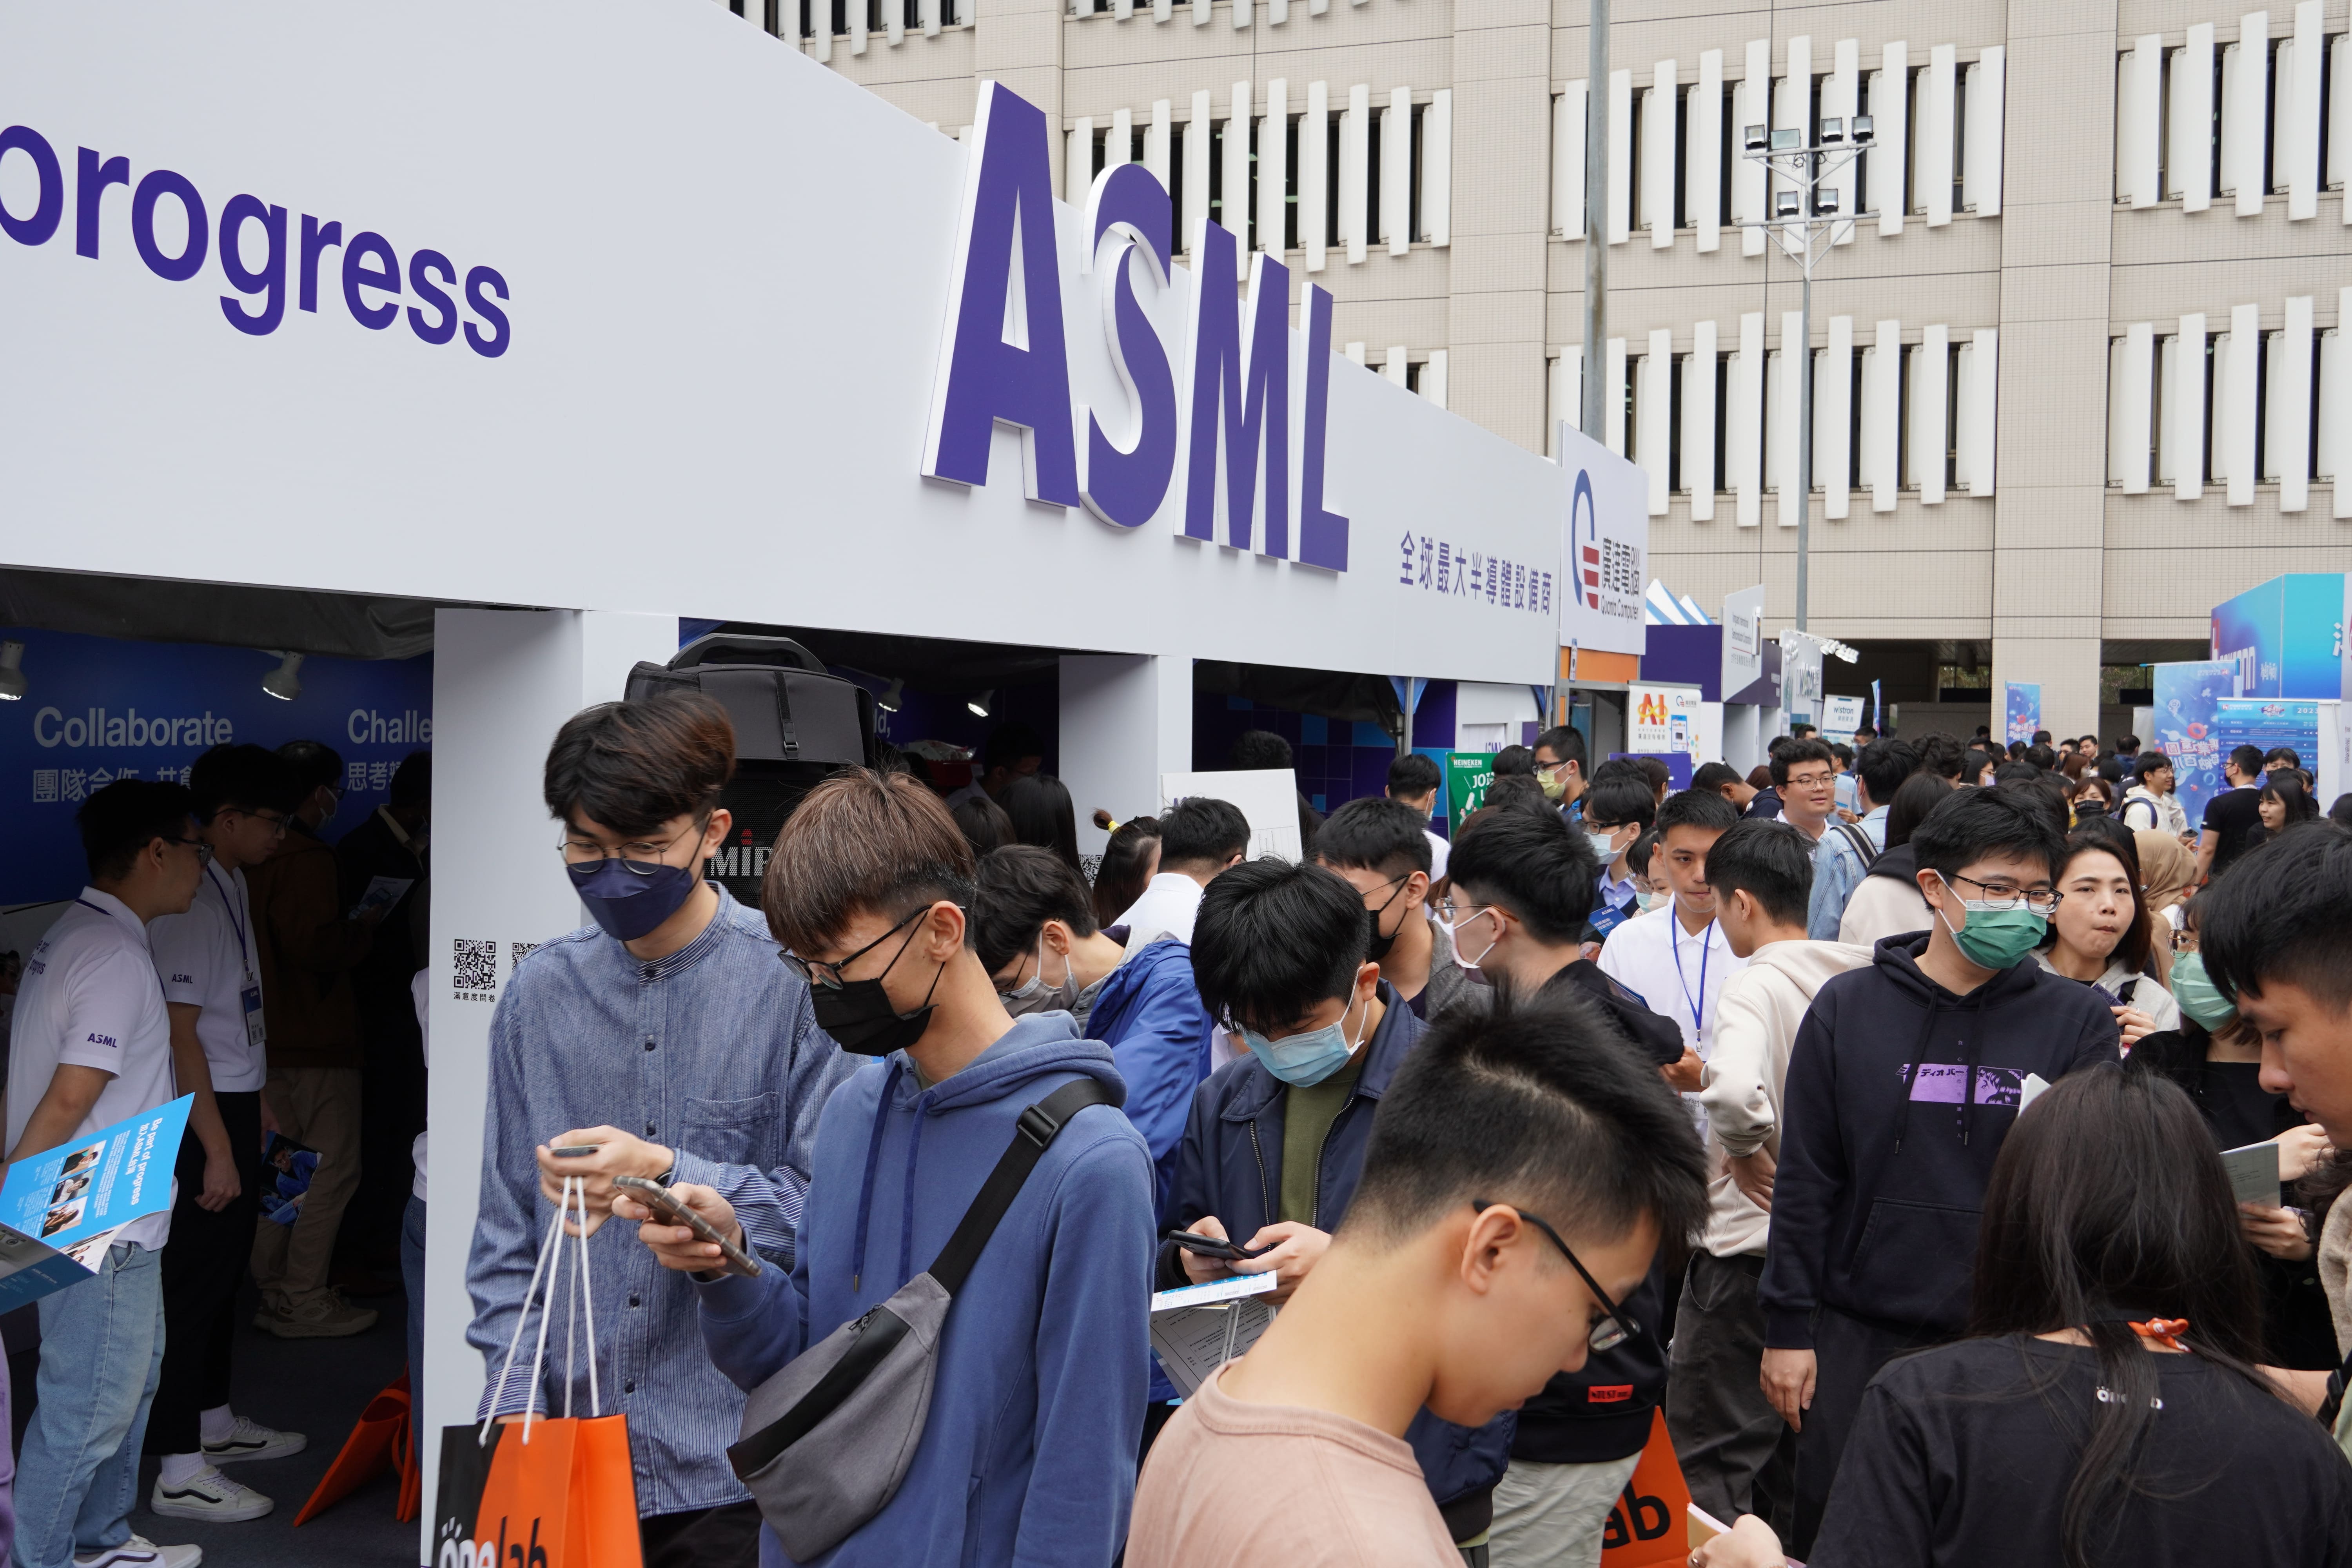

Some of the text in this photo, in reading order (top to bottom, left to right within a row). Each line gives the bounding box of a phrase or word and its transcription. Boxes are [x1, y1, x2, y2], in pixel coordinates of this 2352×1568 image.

[921, 80, 1350, 573] ASML
[1400, 530, 1552, 616] 全球最大半導體設備商
[1602, 536, 1640, 598] 廣達電腦
[1601, 595, 1639, 623] Quanta Computer
[1639, 693, 1665, 725] AI
[34, 706, 233, 748] Collaborate
[347, 761, 401, 791] 思考
[171, 973, 193, 984] ASML
[454, 991, 496, 1003] 滿意度問卷
[87, 1033, 117, 1048] ASML
[141, 1151, 151, 1161] of
[143, 1132, 156, 1151] part
[131, 1161, 147, 1205] progress
